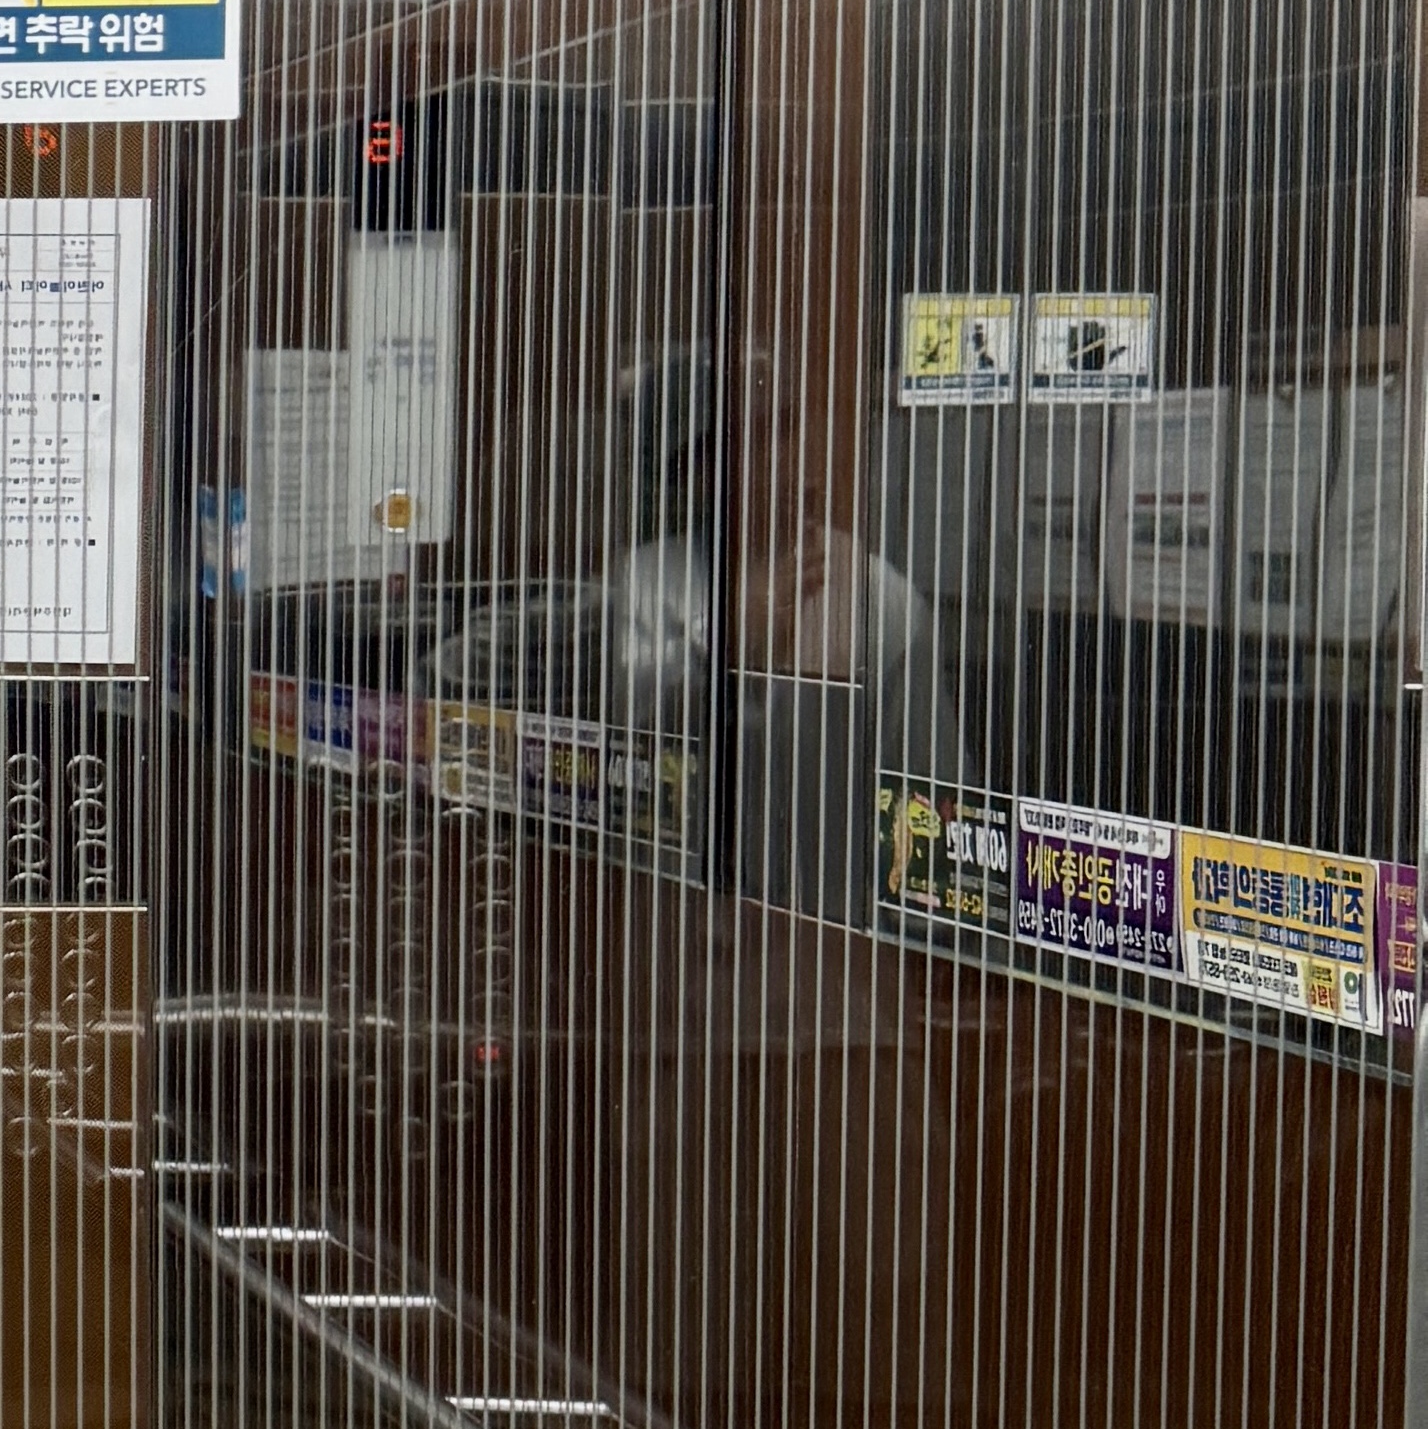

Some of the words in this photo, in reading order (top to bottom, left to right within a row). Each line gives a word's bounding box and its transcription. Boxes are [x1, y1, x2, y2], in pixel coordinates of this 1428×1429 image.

[24, 15, 93, 54] 추락
[97, 12, 165, 53] 위험
[0, 77, 98, 102] SERVICE
[105, 75, 207, 100] EXPERTS
